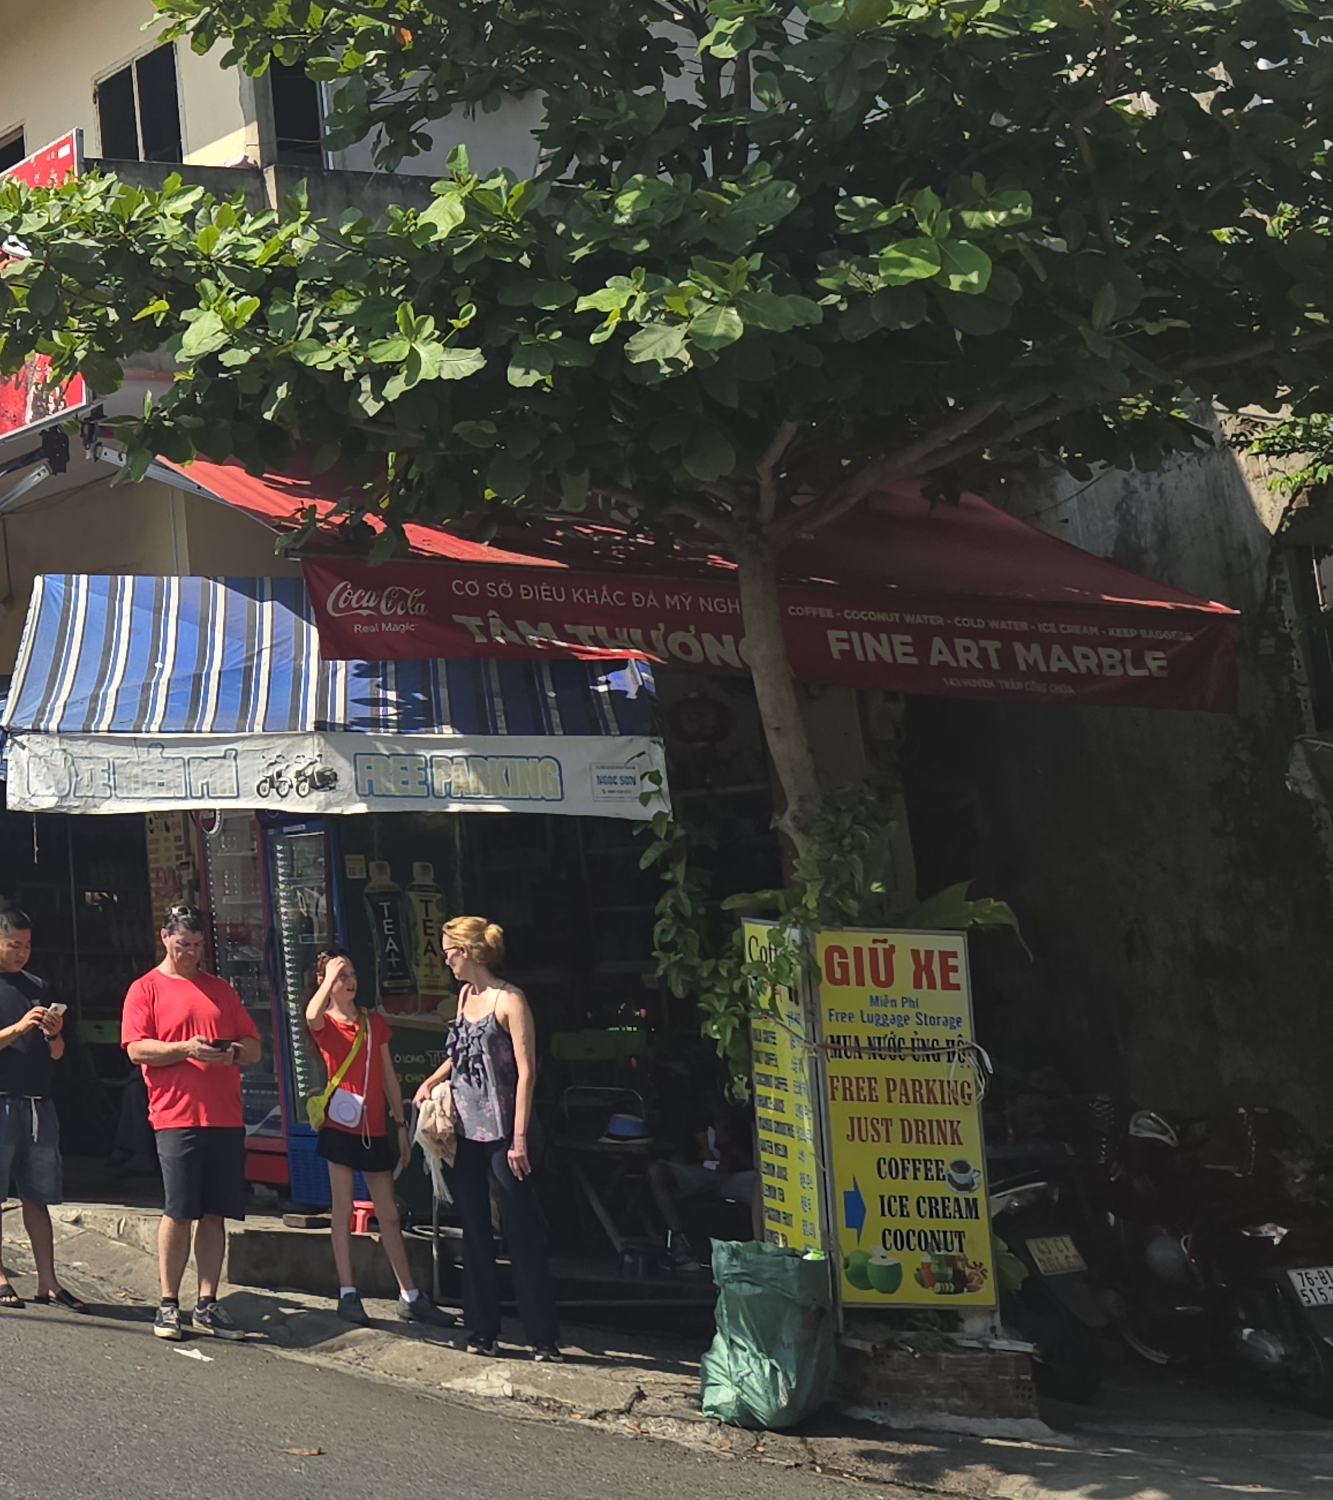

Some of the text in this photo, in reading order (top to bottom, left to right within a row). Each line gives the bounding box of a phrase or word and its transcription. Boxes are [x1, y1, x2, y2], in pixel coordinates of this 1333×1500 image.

[451, 578, 741, 615] CƠ SỞ ĐIÊU KHẮC ĐÁ MỸ NGH
[354, 623, 379, 633] Real
[787, 605, 834, 618] COFFEE
[844, 609, 901, 623] COCONUT
[903, 612, 944, 626] WATER
[954, 616, 985, 629] COLD
[987, 619, 1029, 632] WATER
[1059, 623, 1099, 636] CREAM
[826, 629, 1170, 678] FINE ART MARBLE
[353, 752, 564, 802] FREE PARKING
[824, 938, 961, 991] GIỮ XE
[828, 1008, 963, 1030] Free Luggage Storage
[828, 1075, 973, 1106] FREE PARKING
[846, 1116, 964, 1146] JUST DRINK
[876, 1157, 946, 1181] COFFEE
[878, 1194, 980, 1220] ICE CREAM
[881, 1228, 965, 1253] COCONUT
